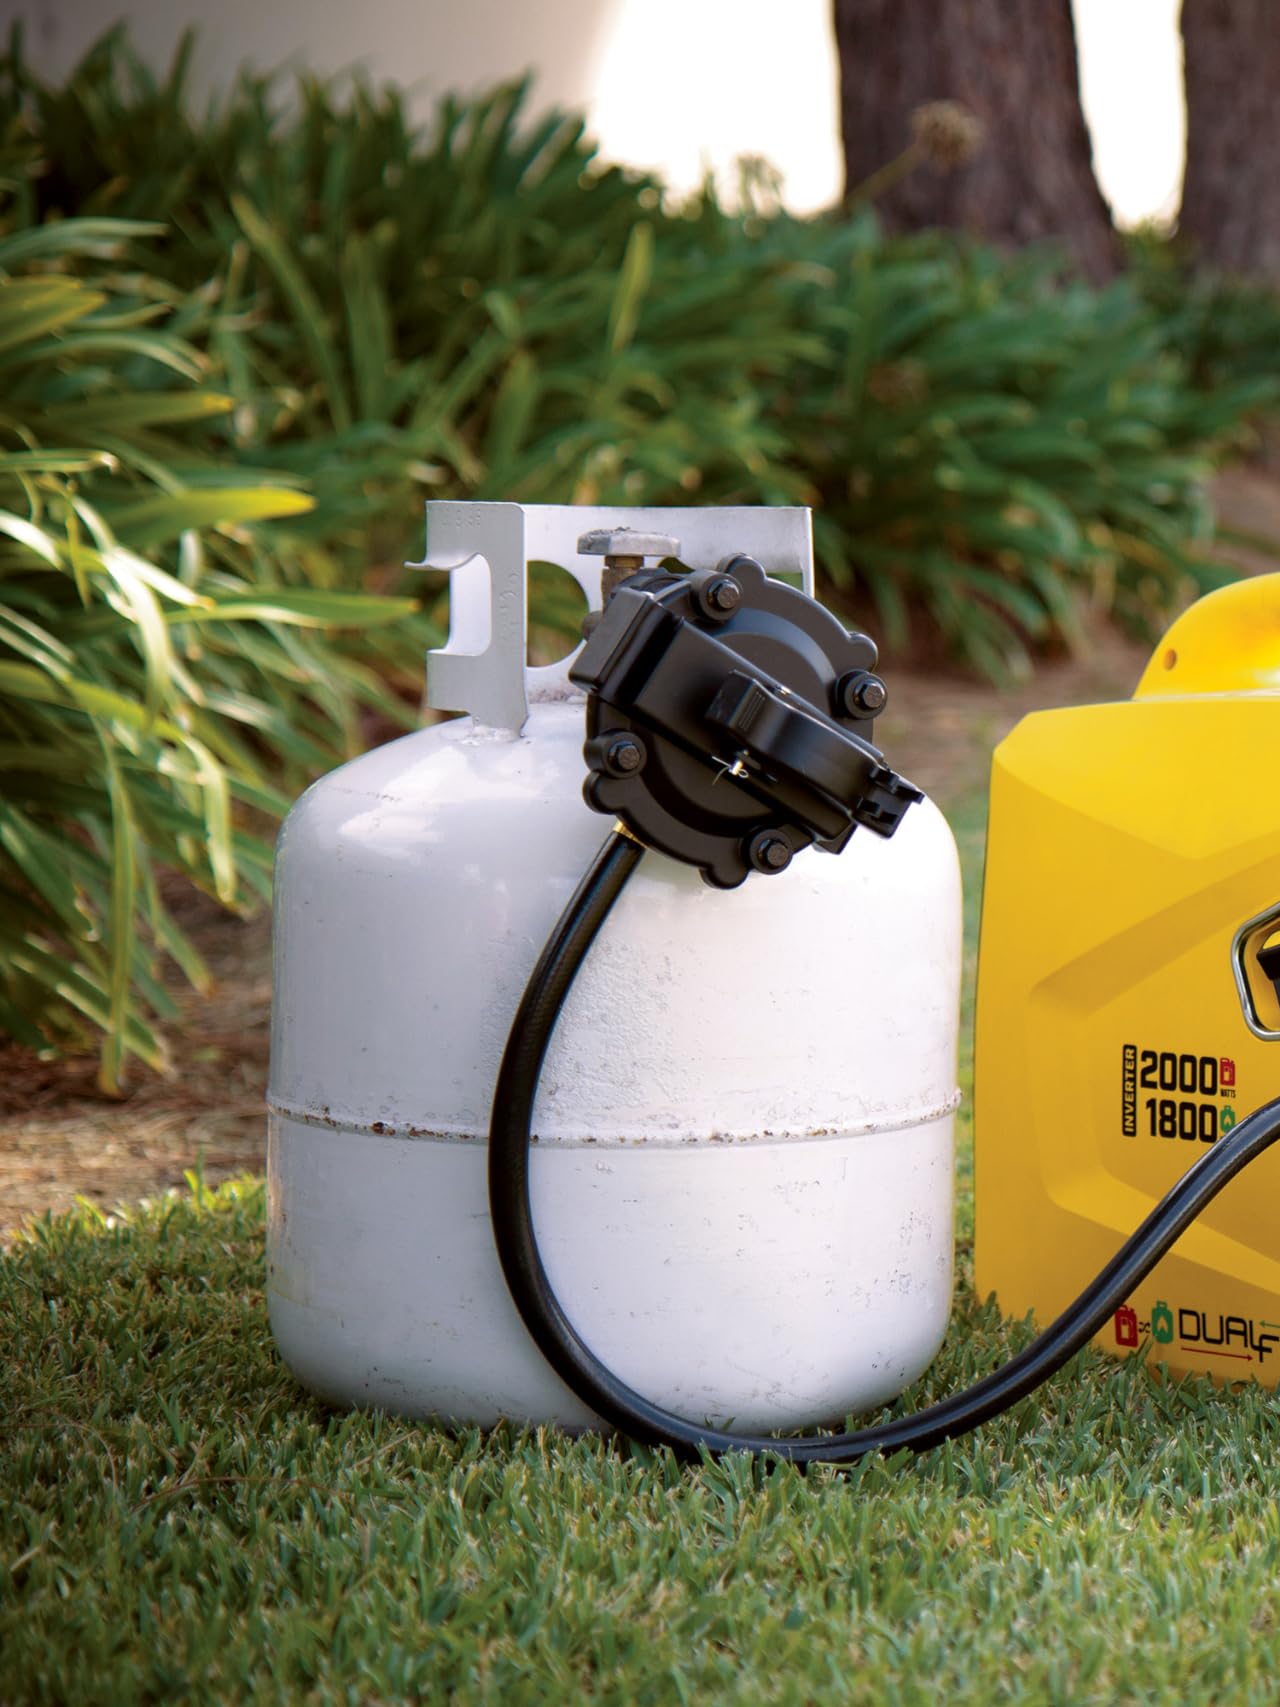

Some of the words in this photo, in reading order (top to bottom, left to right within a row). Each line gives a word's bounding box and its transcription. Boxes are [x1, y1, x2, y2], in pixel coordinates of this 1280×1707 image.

[1124, 1047, 1135, 1133] INVERTER
[1141, 1050, 1217, 1096] 2000
[1220, 1088, 1236, 1098] WATTS
[1146, 1098, 1217, 1143] 1800
